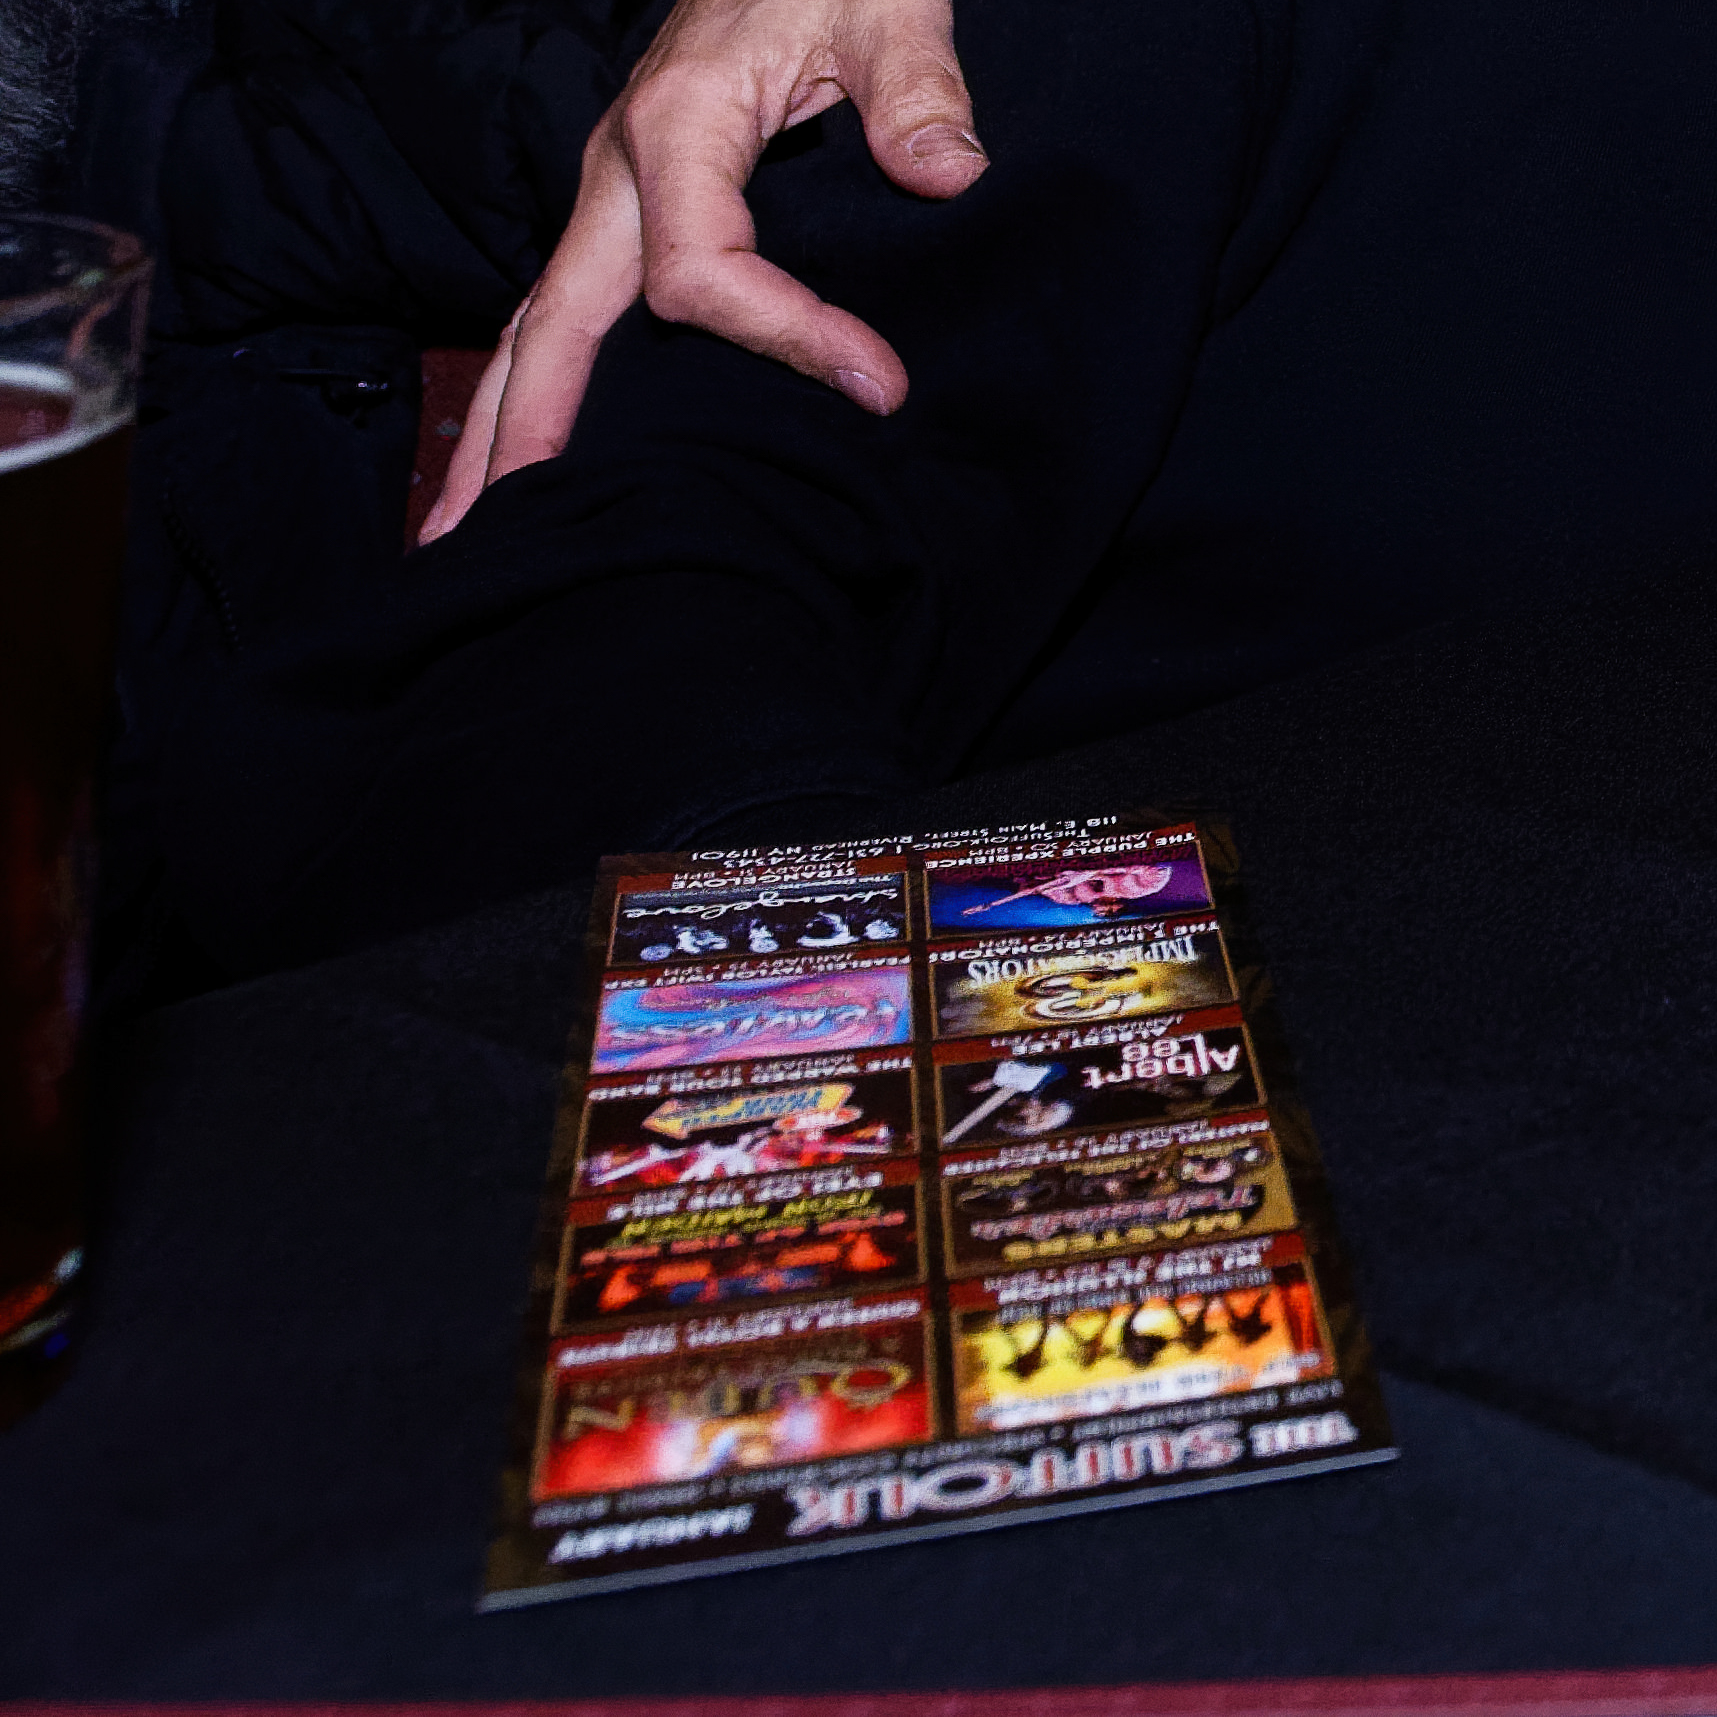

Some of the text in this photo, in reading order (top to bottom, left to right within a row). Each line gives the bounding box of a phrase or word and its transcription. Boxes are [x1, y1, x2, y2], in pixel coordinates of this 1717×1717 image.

[1066, 829, 1152, 848] JANUARY
[689, 846, 757, 861] 11901
[765, 844, 802, 856] NY
[922, 830, 1195, 870] THE PURPLE XPERIENCE
[670, 865, 856, 890] STRANGELOVE
[1171, 919, 1220, 936] THE
[864, 1055, 912, 1074] THE
